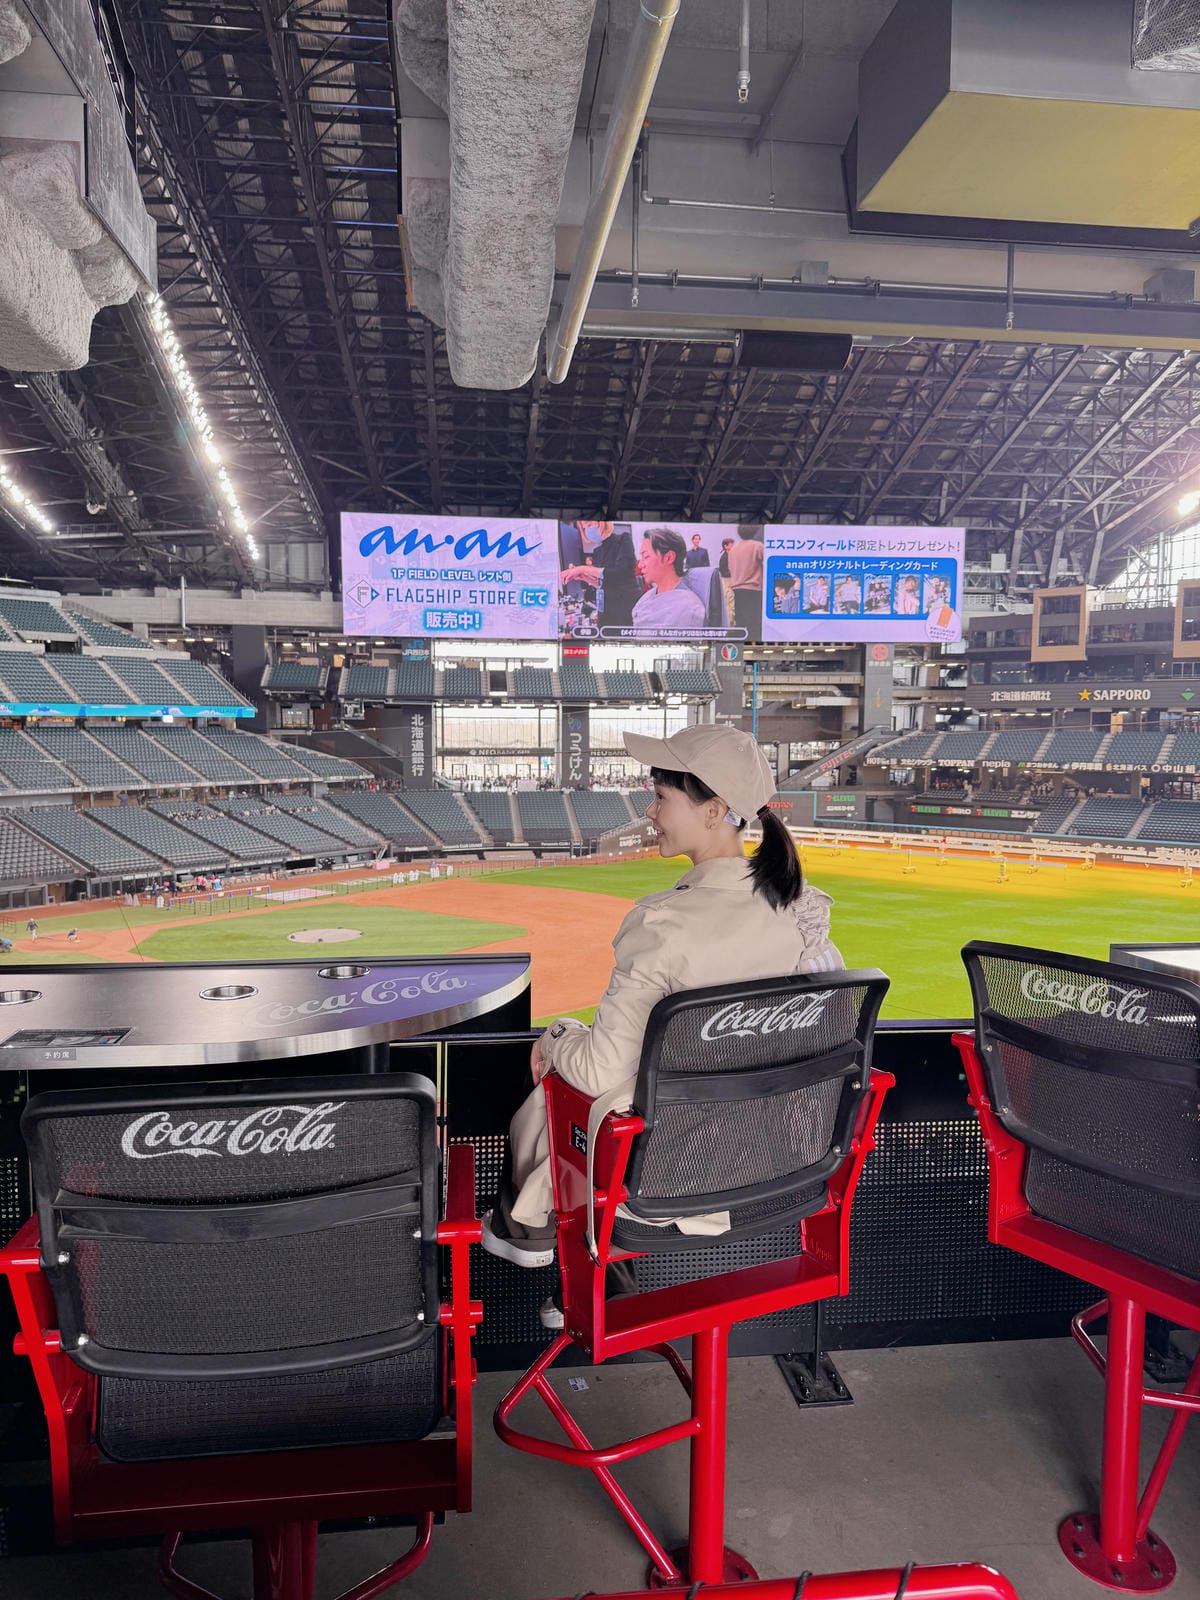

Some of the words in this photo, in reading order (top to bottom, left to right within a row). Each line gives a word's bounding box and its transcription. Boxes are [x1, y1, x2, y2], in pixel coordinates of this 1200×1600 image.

[392, 568, 405, 578] 1F
[408, 569, 438, 579] FIELD
[441, 570, 475, 580] LEVEL
[386, 587, 462, 604] FLAGSHIP
[469, 589, 517, 605] STORE
[523, 591, 548, 605] にて
[426, 611, 480, 629] 販売中!
[1093, 689, 1151, 701] SAPPORO
[411, 713, 425, 776] 北海道銀行
[569, 732, 583, 780] つうけん
[820, 747, 856, 773] FUJITEC
[938, 759, 976, 767] TOPPAN
[982, 759, 1011, 768] nepia
[976, 808, 1009, 817] 7-ELEVEN
[243, 969, 468, 1028] Coca-Cola
[1021, 970, 1150, 1026] Coca-Cola
[700, 988, 840, 1041] Coca-Cola
[44, 1051, 70, 1060] 予約席
[121, 1101, 346, 1159] Coca-Cola
